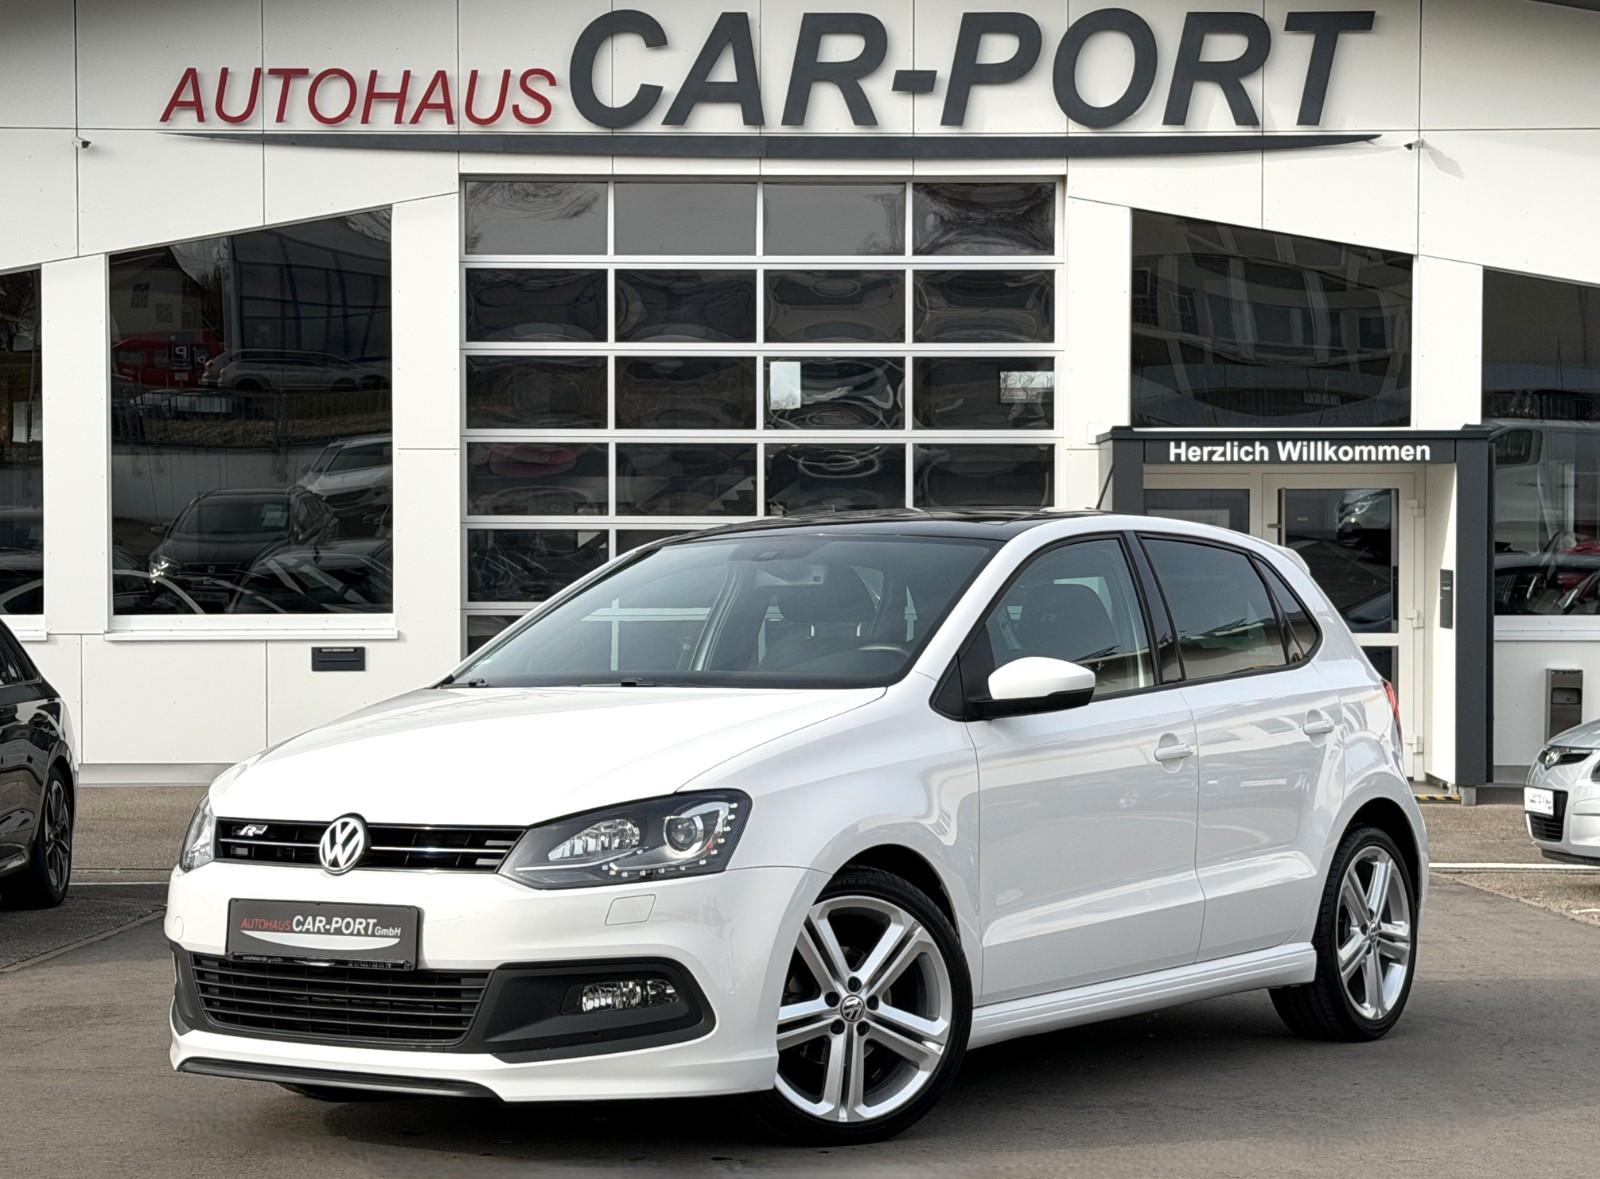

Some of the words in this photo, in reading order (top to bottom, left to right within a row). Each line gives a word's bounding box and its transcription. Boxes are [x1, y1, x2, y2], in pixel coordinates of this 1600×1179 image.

[160, 66, 558, 125] AUTOHAUS
[570, 7, 1375, 129] CAR-PORT
[1168, 440, 1270, 463] Herzlich
[1277, 440, 1431, 463] Willkommen
[241, 917, 292, 931] AUTOHAUS
[292, 915, 378, 936] CAR-PORT
[375, 925, 402, 937] GmbH
